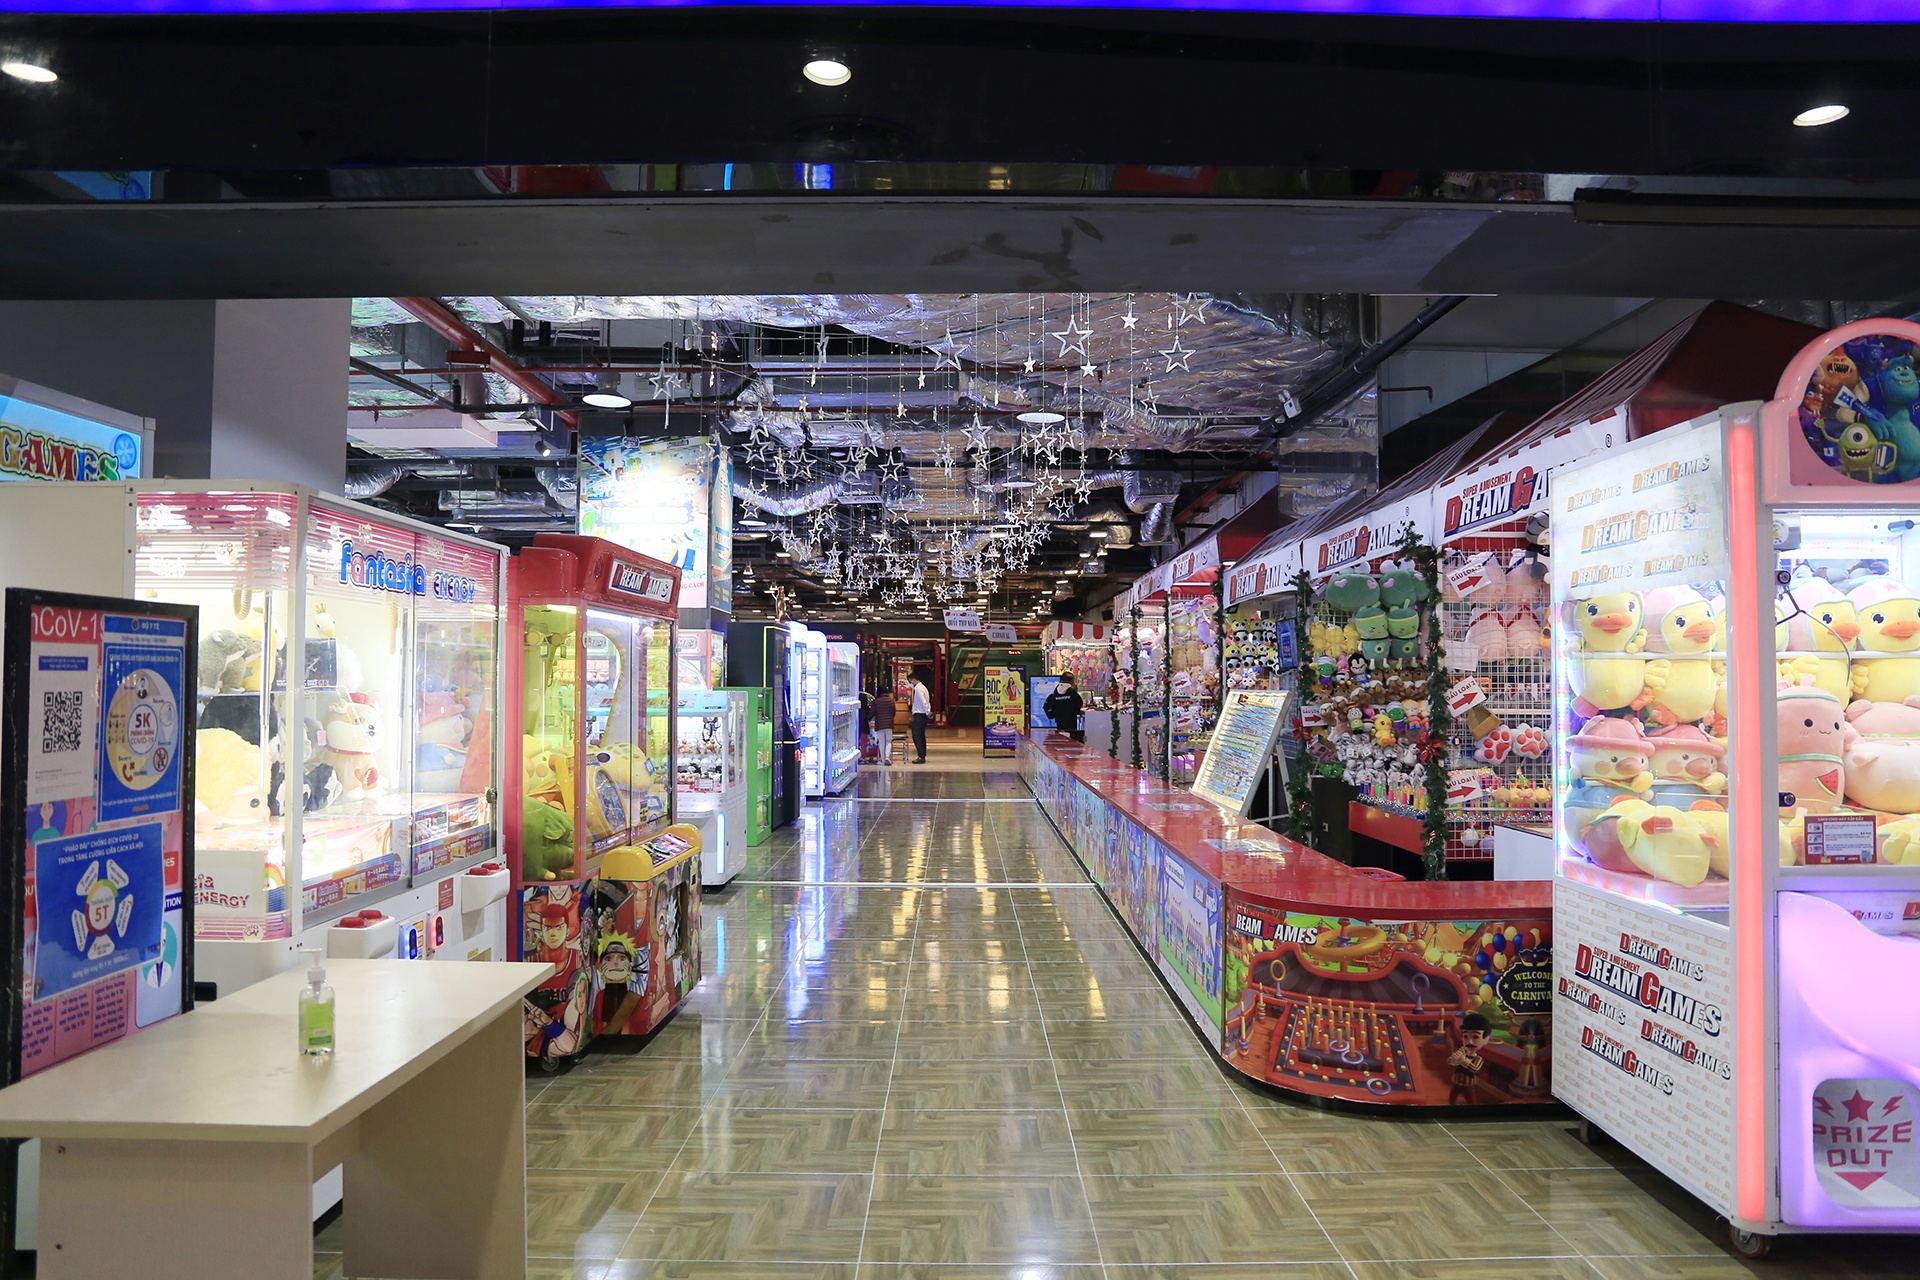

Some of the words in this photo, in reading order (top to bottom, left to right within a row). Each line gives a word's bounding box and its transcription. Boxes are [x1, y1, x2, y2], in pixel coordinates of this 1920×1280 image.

[0, 426, 120, 481] GAMES
[1462, 484, 1478, 499] SUPER
[1480, 471, 1512, 491] AMUSEMENT
[1633, 467, 1669, 492] DREAM
[1669, 454, 1711, 482] GAMES
[1444, 483, 1512, 536] DREAM
[1512, 465, 1554, 512] GA
[1567, 491, 1594, 511] DREAM
[1582, 519, 1633, 553] DREAM
[1318, 535, 1357, 572] DREAM
[1643, 557, 1674, 576] DREAM
[432, 571, 477, 604] ENERGY
[1230, 572, 1258, 604] DREAM
[1571, 568, 1600, 587] DREAM
[31, 606, 104, 640] nCoV-1
[135, 713, 151, 728] 5K
[130, 736, 154, 745] COVID-19
[95, 904, 110, 922] 5T
[165, 896, 182, 909] TION
[1262, 915, 1318, 946] GAMES
[1593, 946, 1608, 961] SUPER
[1610, 953, 1641, 974] AMUSEMENT
[1619, 932, 1658, 964] DREAM
[1657, 947, 1704, 982] GAMES
[1511, 990, 1553, 1001] CARNIVA
[1558, 977, 1590, 1006] DREAM
[1590, 992, 1626, 1025] GAMES
[1576, 943, 1640, 997] DREAM
[1640, 971, 1722, 1038] GAMES
[1581, 1026, 1624, 1065] DREAM
[1623, 1049, 1674, 1096] GAMES
[1641, 1018, 1682, 1055] DREAM
[1682, 1040, 1731, 1080] GAMES
[1813, 1120, 1912, 1143] PRIZE
[1827, 1149, 1893, 1168] OUT
